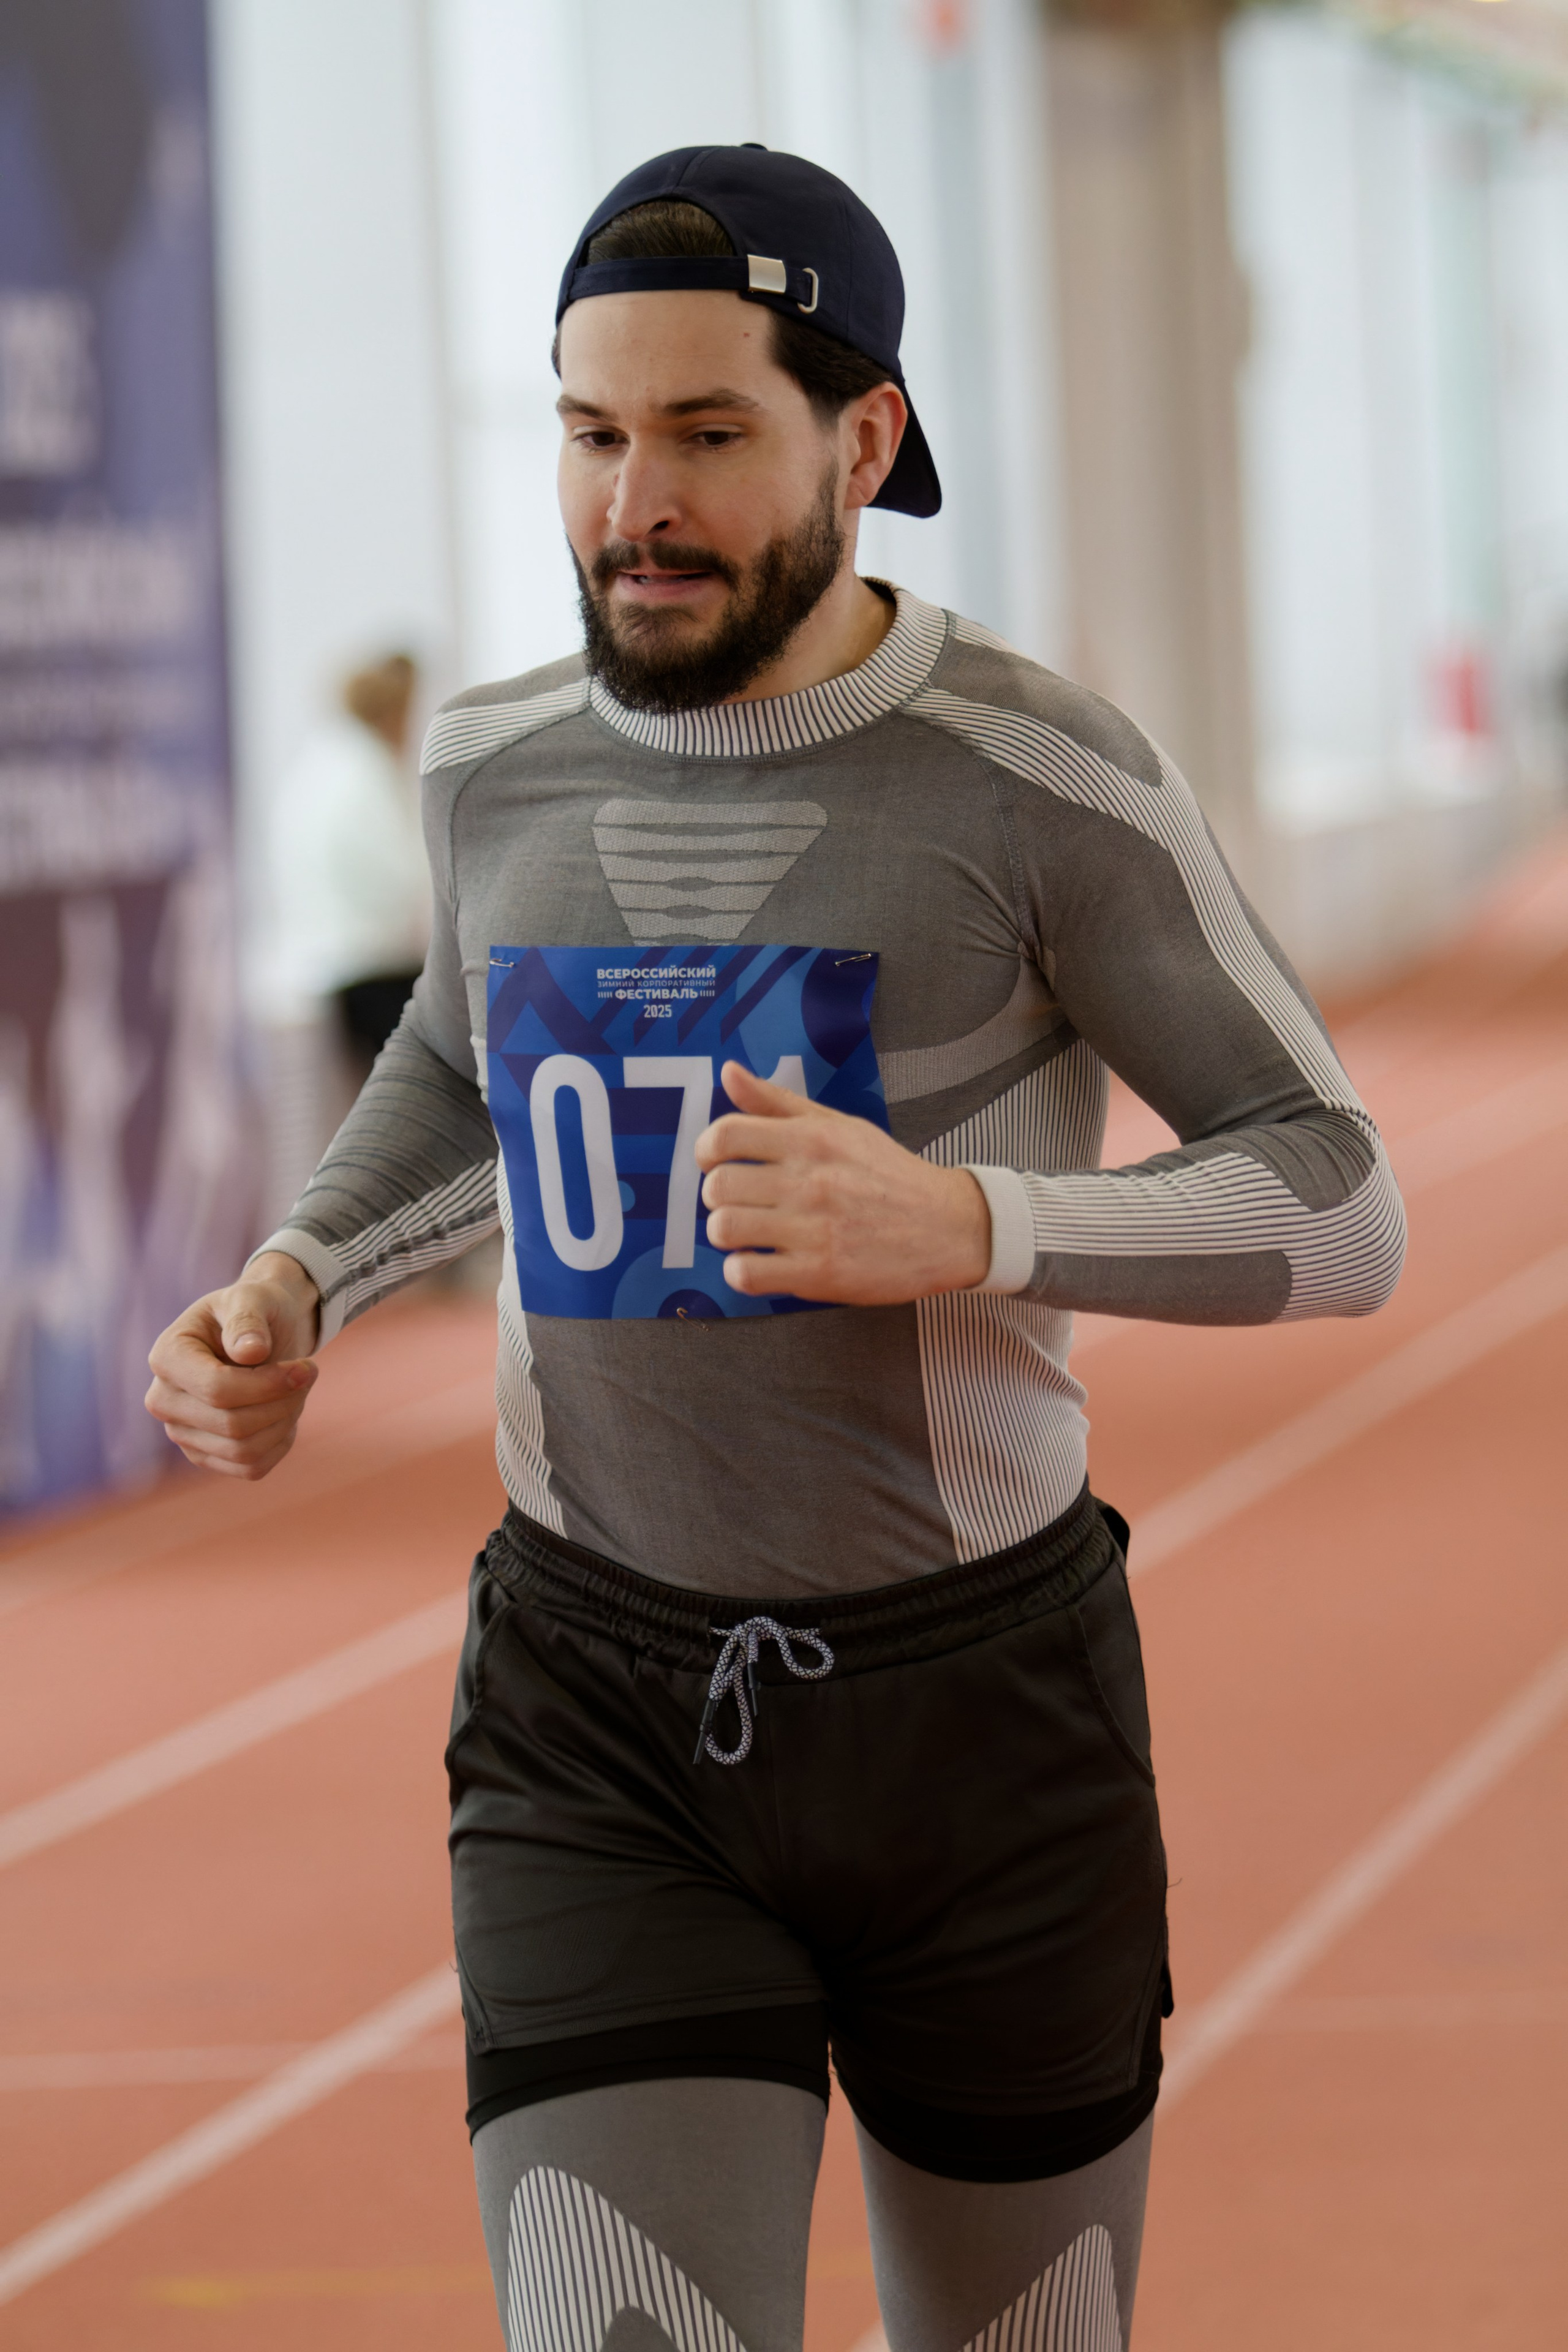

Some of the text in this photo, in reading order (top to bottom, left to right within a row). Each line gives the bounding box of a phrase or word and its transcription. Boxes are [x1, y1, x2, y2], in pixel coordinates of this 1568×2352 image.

[597, 965, 716, 979] ВСЕРОССИЙСКИЙ
[597, 979, 715, 988] ЗИМНИЙ КОРПОРАТИВНЫЙ
[615, 989, 698, 1000] ФЕСТИВАЛЬ
[644, 1005, 672, 1018] 2025
[530, 1054, 808, 1271] 07
